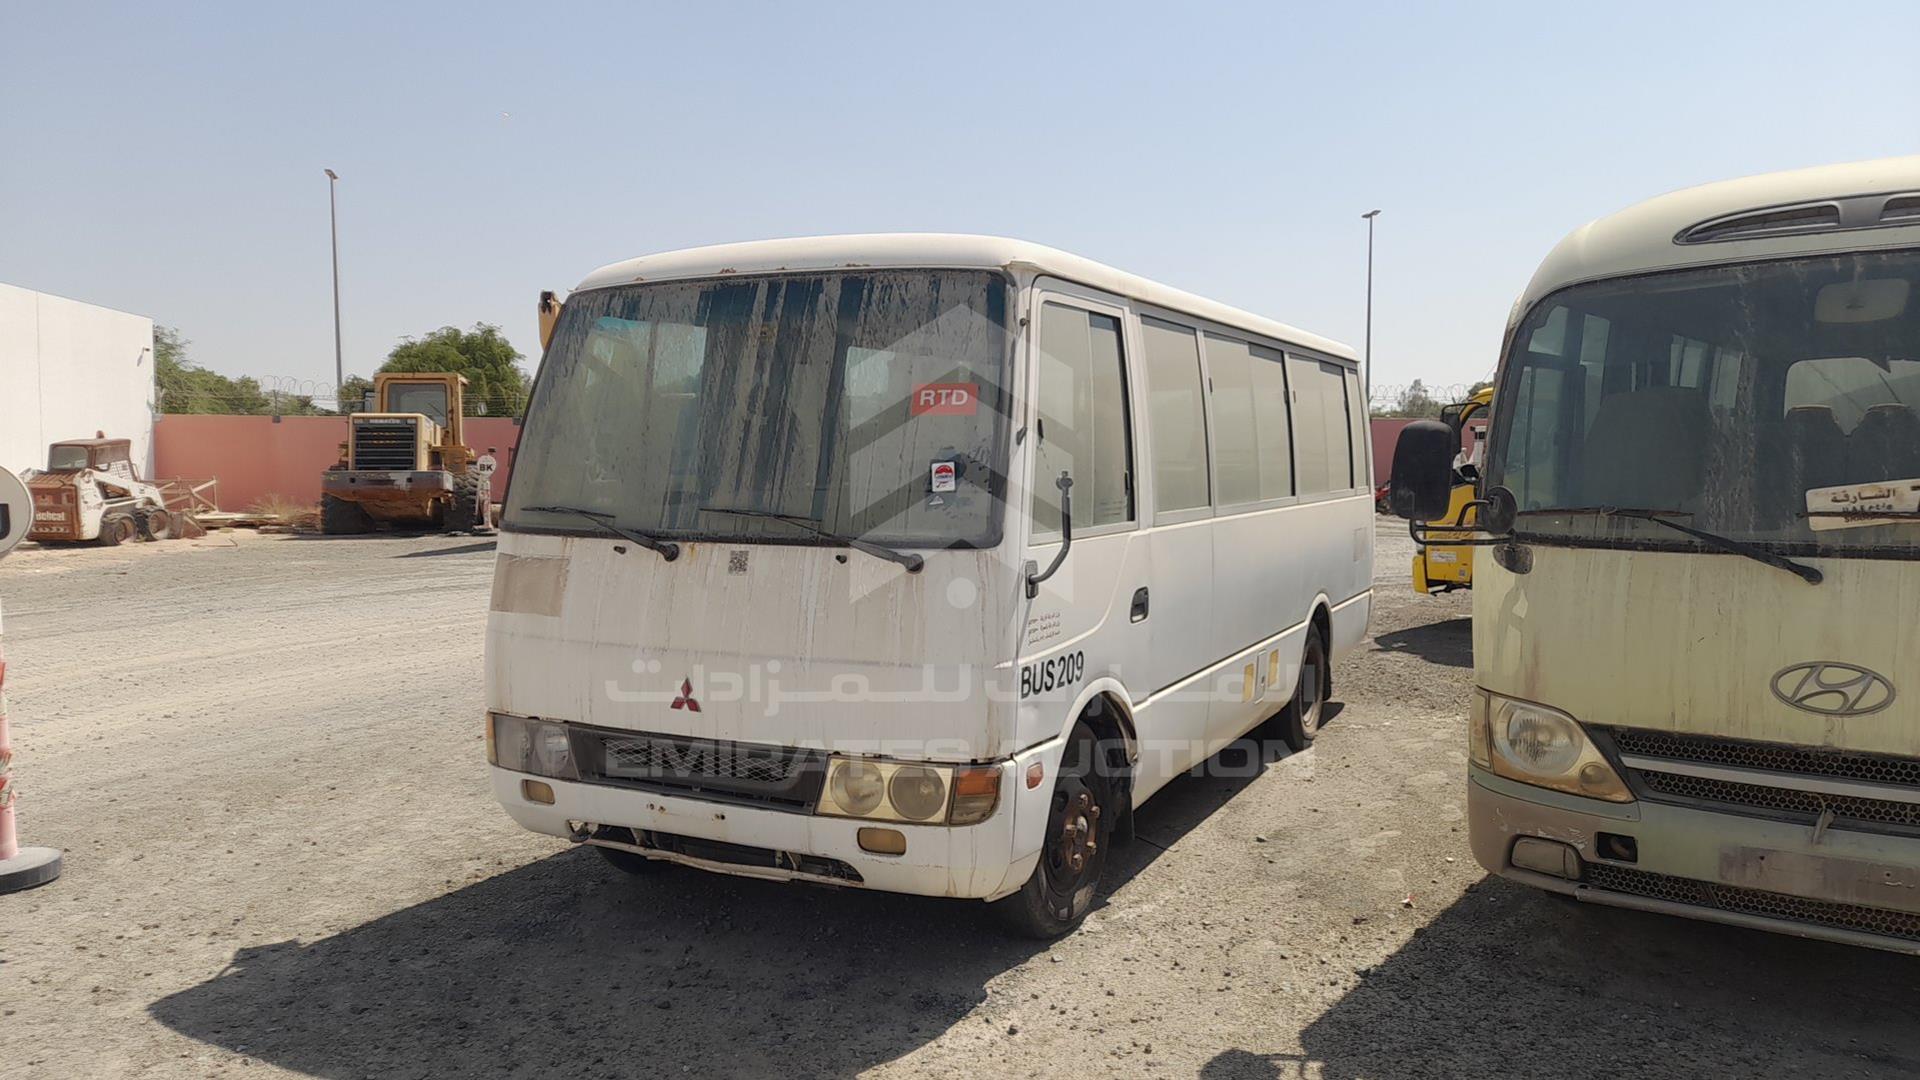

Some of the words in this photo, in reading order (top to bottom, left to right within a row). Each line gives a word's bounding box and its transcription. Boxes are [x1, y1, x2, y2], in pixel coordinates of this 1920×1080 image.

[919, 389, 969, 406] RTD
[479, 464, 493, 472] BK
[1830, 487, 1896, 504] الشارقة
[1021, 658, 1055, 699] BUS
[1056, 650, 1084, 688] 209
